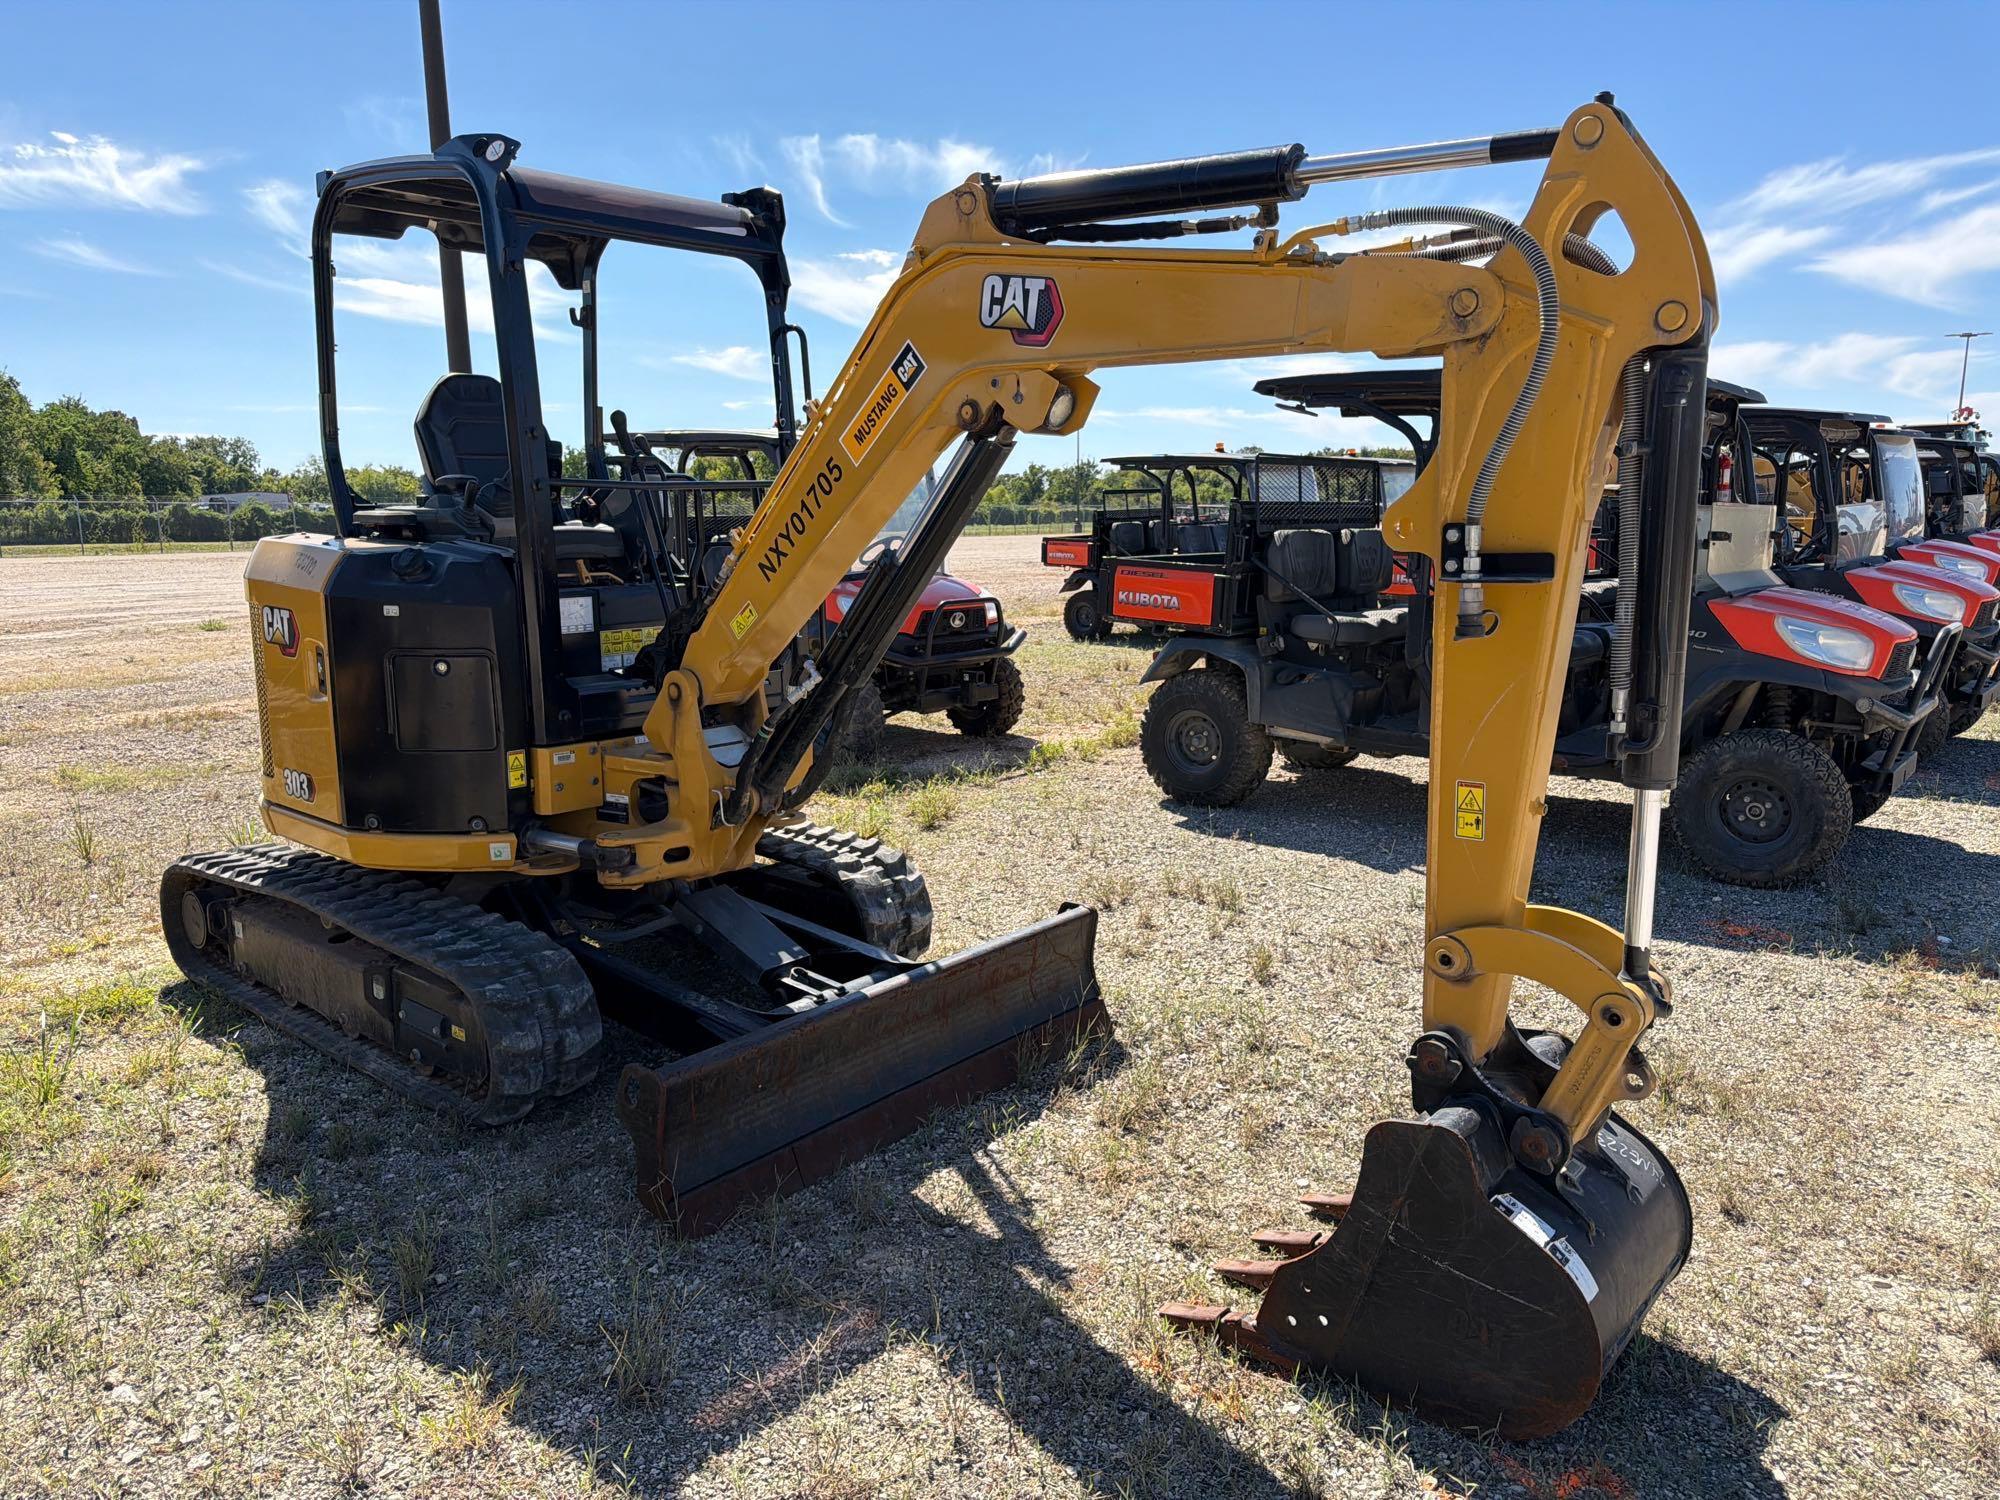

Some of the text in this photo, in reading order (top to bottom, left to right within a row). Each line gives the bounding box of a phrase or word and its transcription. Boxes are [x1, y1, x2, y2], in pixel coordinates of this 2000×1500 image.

[981, 275, 1046, 329] CAT
[853, 351, 919, 446] MUSTANG CAT
[757, 455, 843, 583] NXY01705
[1118, 590, 1181, 611] KUBOTA
[262, 606, 290, 646] CAT
[283, 768, 309, 800] 303
